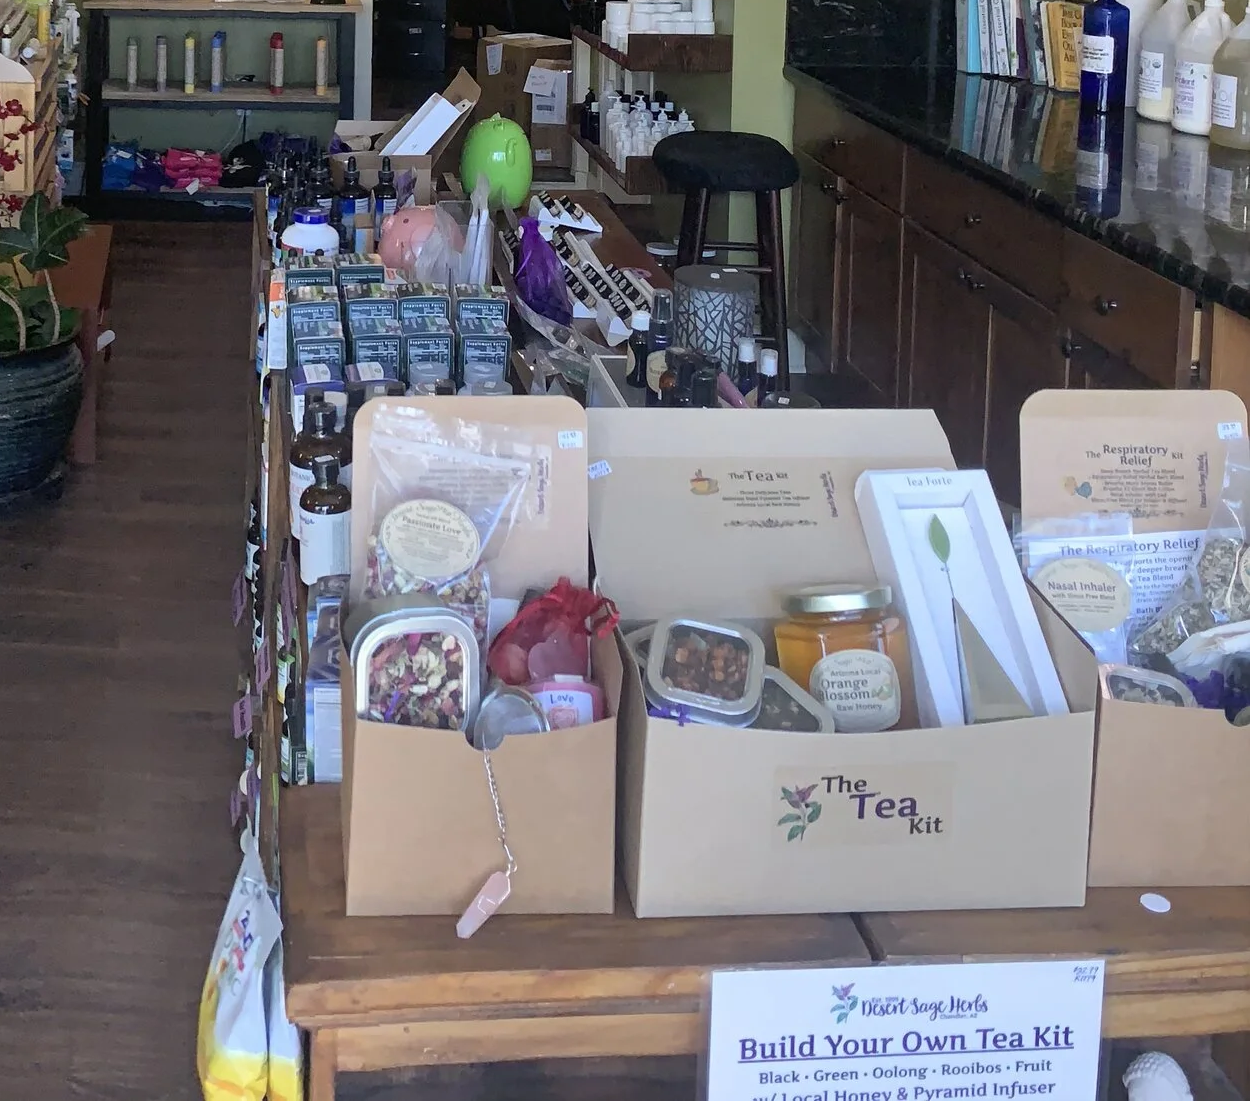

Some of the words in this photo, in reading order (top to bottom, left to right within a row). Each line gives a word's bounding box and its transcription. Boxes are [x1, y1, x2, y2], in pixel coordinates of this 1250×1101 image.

[1086, 451, 1101, 459] The
[1102, 444, 1168, 456] Respiratory
[1171, 452, 1184, 460] Kit
[1120, 455, 1152, 467] Relief
[728, 472, 745, 481] The
[744, 470, 774, 482] Tea
[442, 524, 462, 536] Love
[1059, 545, 1082, 557] The
[1086, 540, 1160, 557] Respiratory
[1163, 537, 1201, 552] Relief
[1137, 566, 1164, 576] deeper
[1152, 573, 1174, 581] Blend
[1047, 581, 1078, 592] Nasal
[1080, 581, 1117, 593] Inhaler
[821, 678, 869, 690] Orange
[549, 693, 575, 705] Love
[856, 703, 883, 712] Honey
[821, 774, 868, 794] The
[849, 791, 919, 820] Tea
[908, 816, 944, 835] Kit
[862, 996, 909, 1017] Desert
[910, 997, 948, 1022] Sage
[948, 993, 989, 1014] Herbs
[739, 1035, 816, 1060] Build
[824, 1033, 894, 1057] Your
[902, 1031, 967, 1054] Own
[975, 1027, 1025, 1051] Tea
[1033, 1025, 1075, 1048] Kit
[758, 1070, 801, 1085] Black
[813, 1069, 859, 1083] Green
[872, 1066, 929, 1083] Oolong
[941, 1062, 1002, 1077] Rooibos
[1015, 1059, 1054, 1074] Fruit
[834, 1088, 893, 1101] Honey
[896, 1087, 909, 1101] &
[913, 1082, 988, 1101] Pyramid
[993, 1079, 1057, 1098] Infuser
